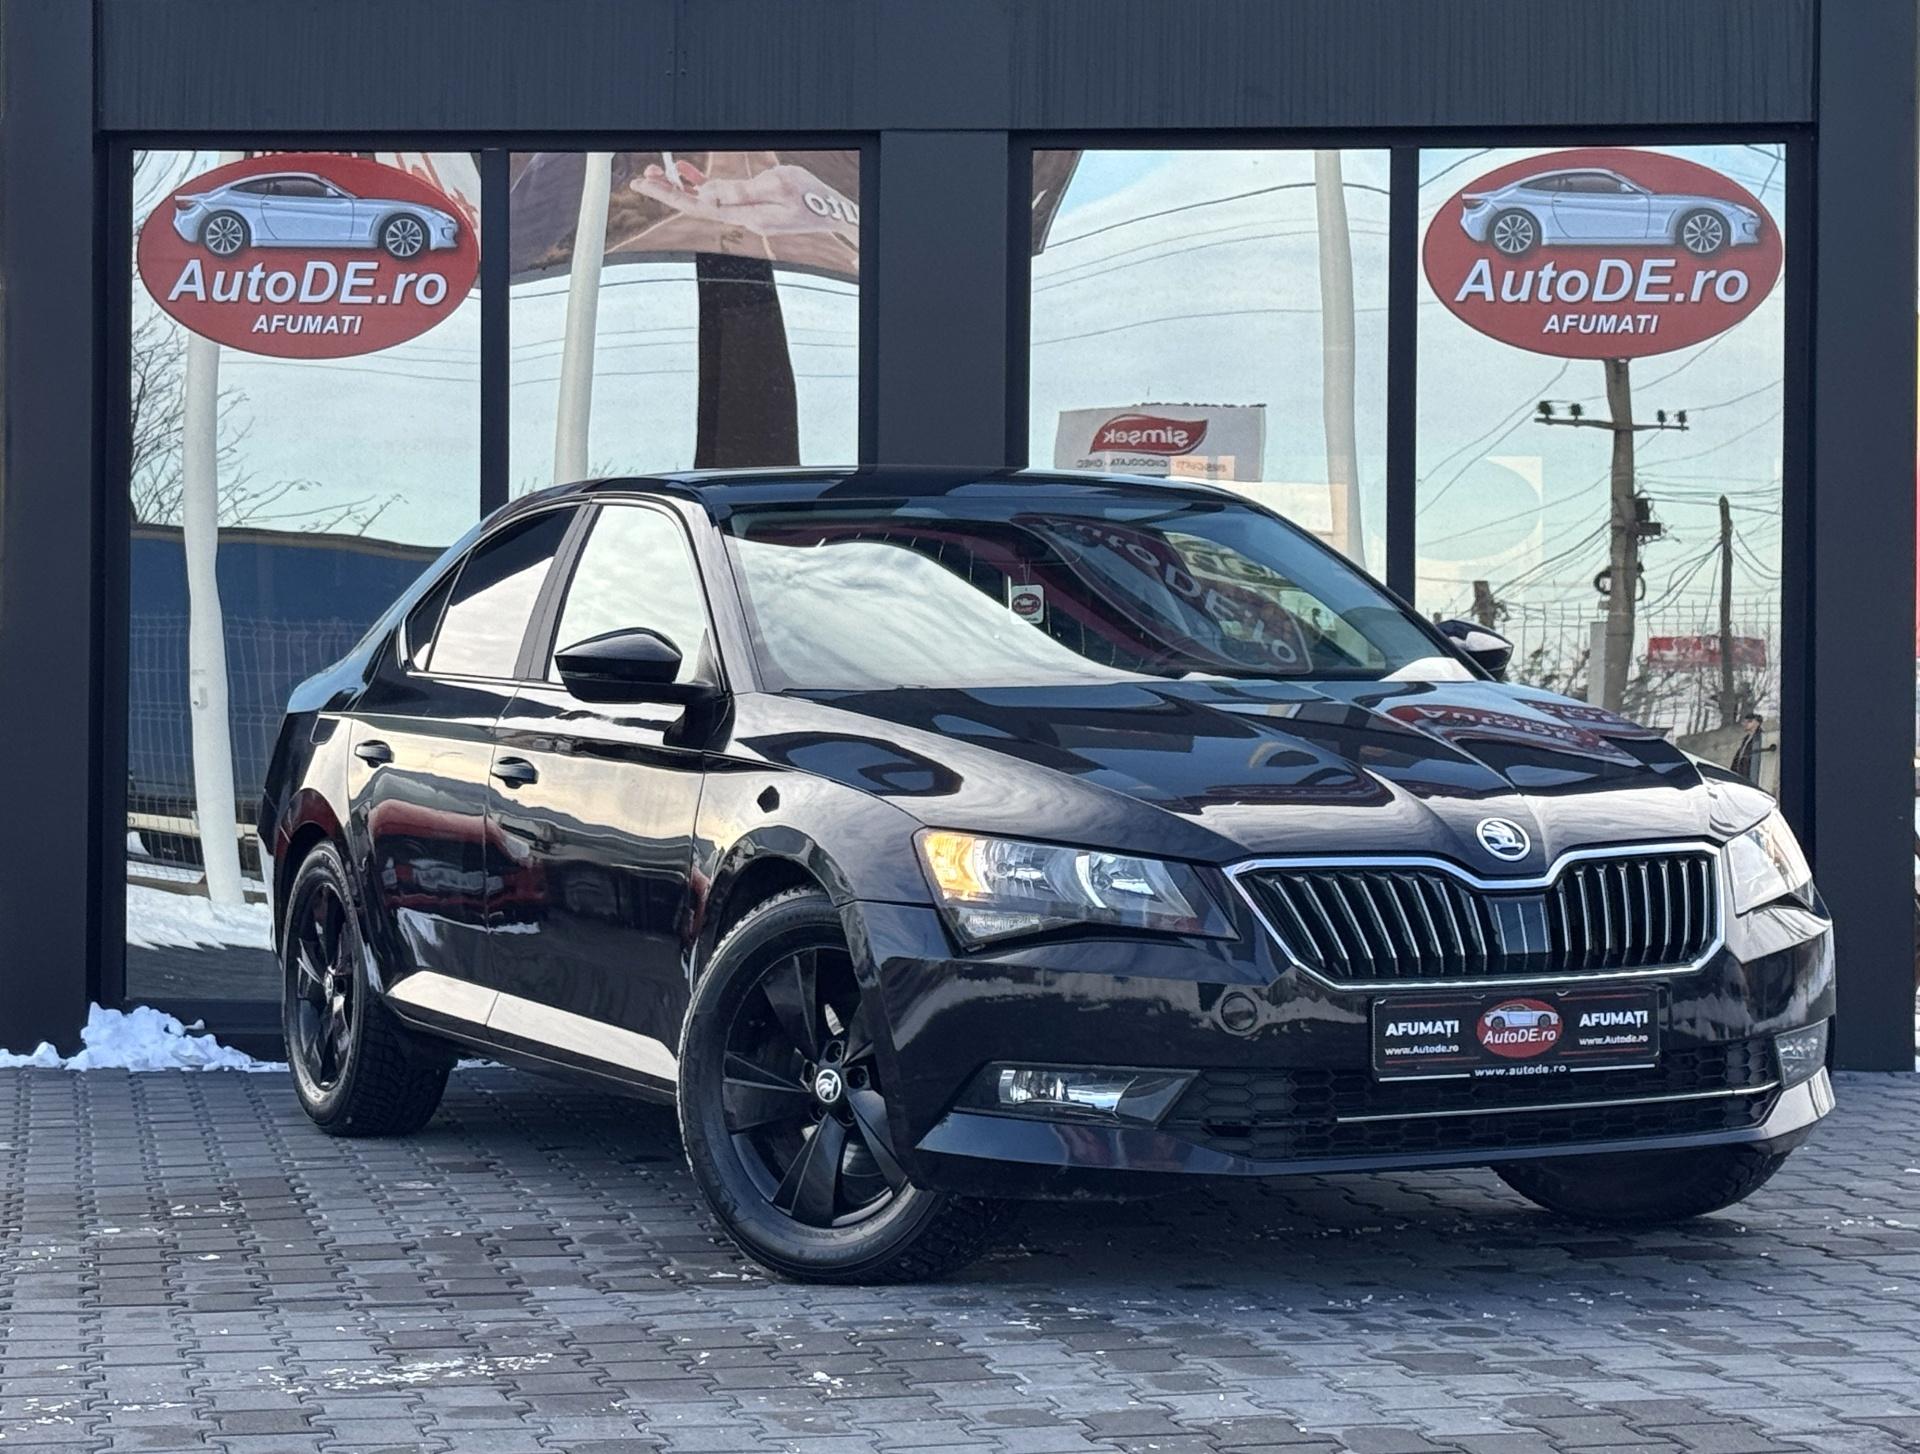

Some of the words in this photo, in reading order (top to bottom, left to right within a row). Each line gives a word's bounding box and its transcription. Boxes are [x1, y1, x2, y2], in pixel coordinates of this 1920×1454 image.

[167, 258, 448, 306] AutoDE.ro
[1454, 258, 1749, 303] AutoDE.ro
[251, 314, 364, 335] AFUMATI
[1542, 314, 1659, 335] AFUMATI
[1579, 1010, 1648, 1028] AFUMAȚI
[1385, 1020, 1459, 1038] AFUMAȚI
[1482, 1028, 1557, 1045] AutoDE.ro
[1579, 1034, 1648, 1045] www.Autode.ro
[1385, 1044, 1459, 1055] www.Autode.ro
[1474, 1064, 1567, 1077] www.autode.ro
